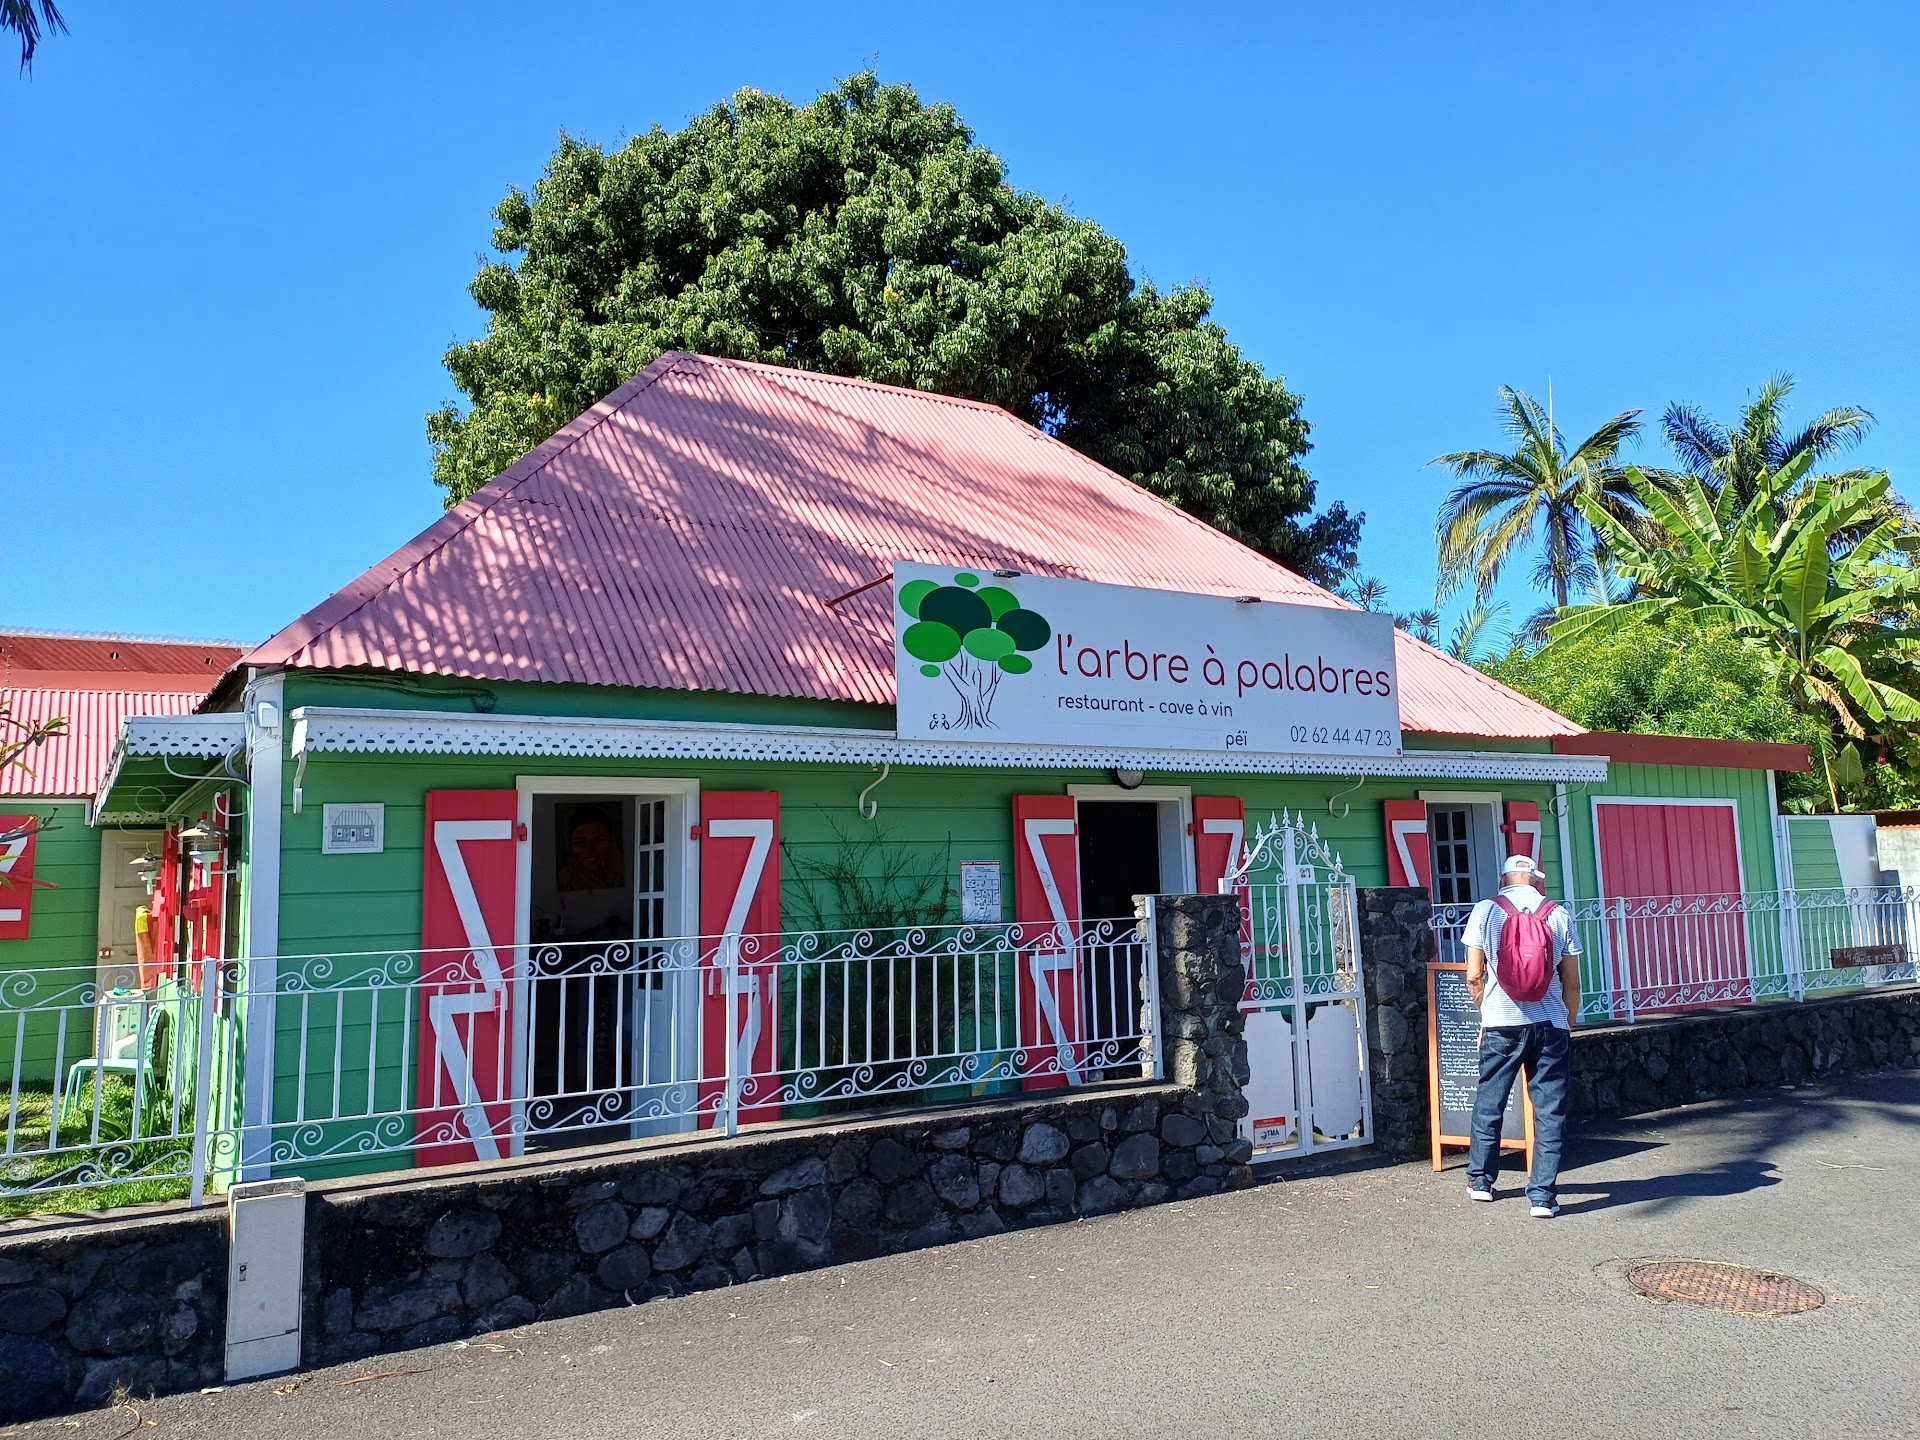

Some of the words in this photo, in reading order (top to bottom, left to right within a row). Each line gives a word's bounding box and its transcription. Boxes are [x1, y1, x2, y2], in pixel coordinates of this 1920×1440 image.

[1057, 633, 1189, 684] l'arbre
[1203, 644, 1225, 686] à
[1237, 653, 1391, 699] palabres
[1058, 694, 1145, 713] restaurant
[1159, 702, 1194, 715] cave
[1198, 699, 1207, 716] à
[1211, 701, 1233, 717] vin
[1226, 730, 1248, 749] péï
[1290, 726, 1308, 743] 02
[1312, 727, 1329, 744] 62
[1332, 728, 1351, 745] 44
[1354, 729, 1371, 746] 47
[1375, 730, 1392, 747] 23
